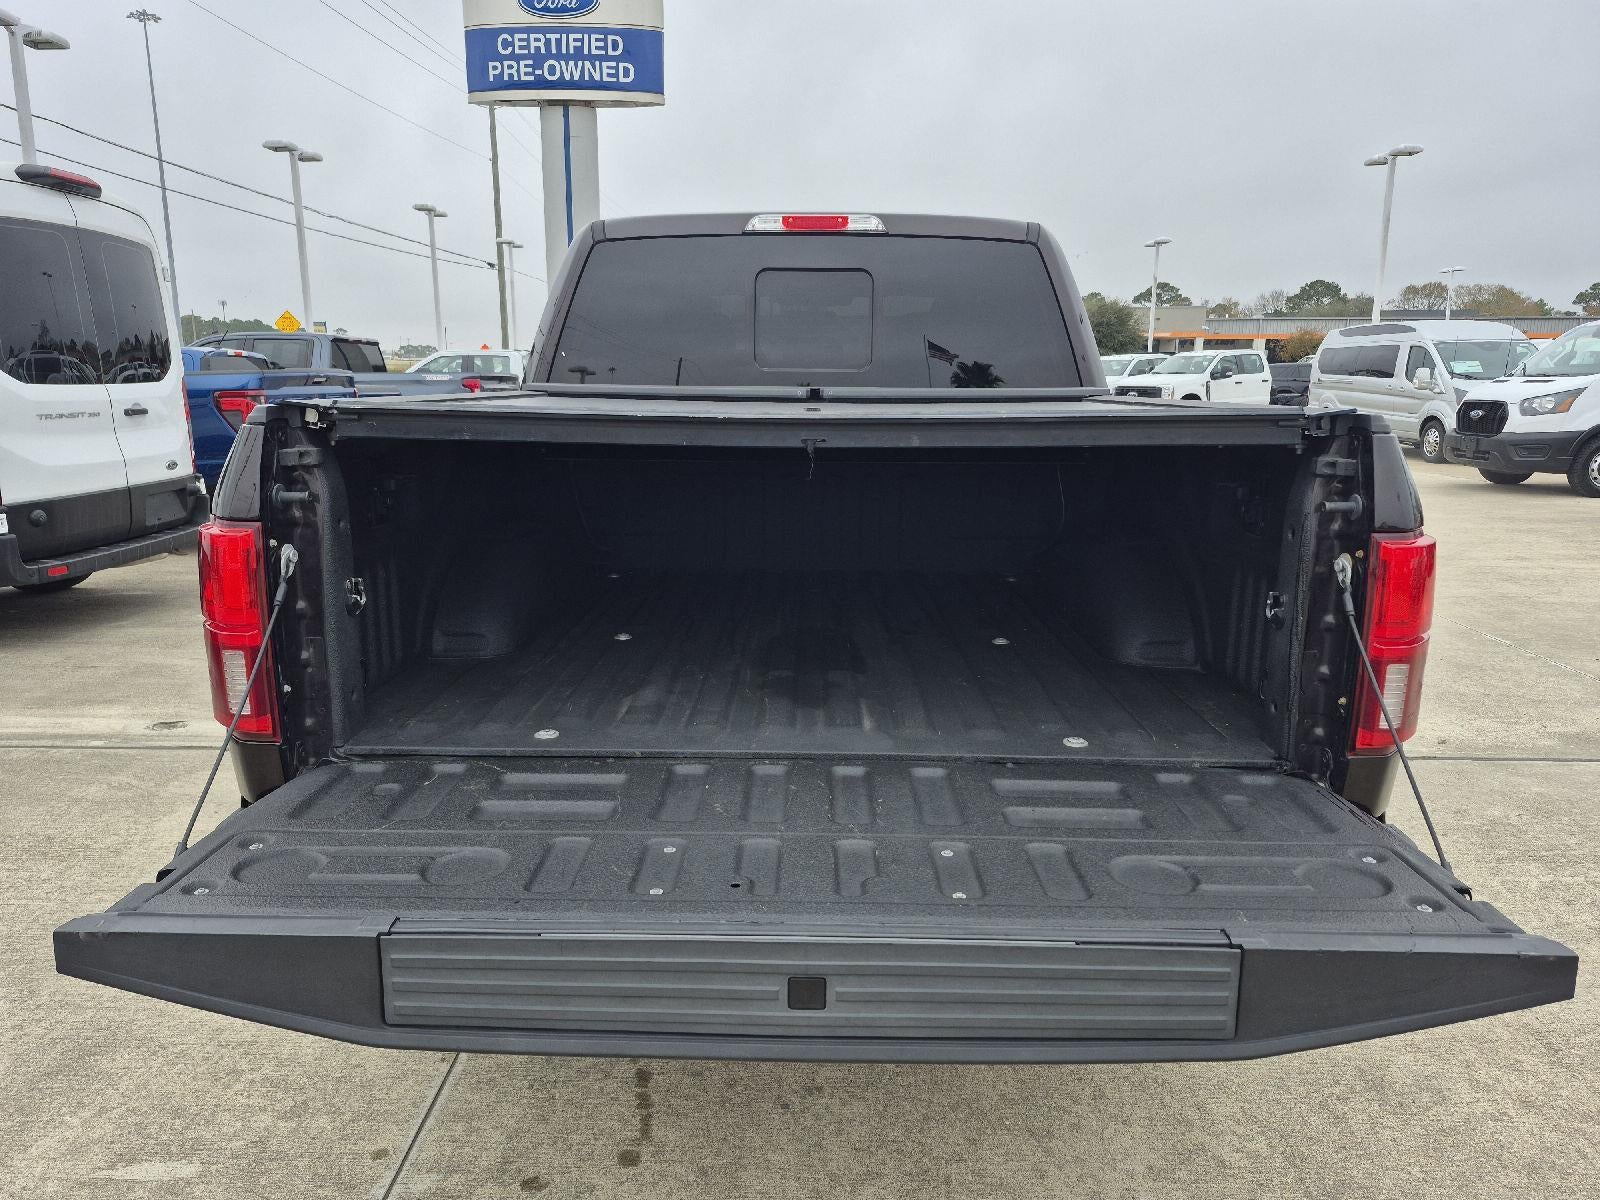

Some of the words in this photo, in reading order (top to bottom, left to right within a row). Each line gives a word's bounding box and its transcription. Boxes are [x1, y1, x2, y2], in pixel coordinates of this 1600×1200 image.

[496, 33, 624, 56] CERTIFIED
[488, 59, 635, 83] PRE-OWNED
[36, 411, 86, 421] TRANSIT
